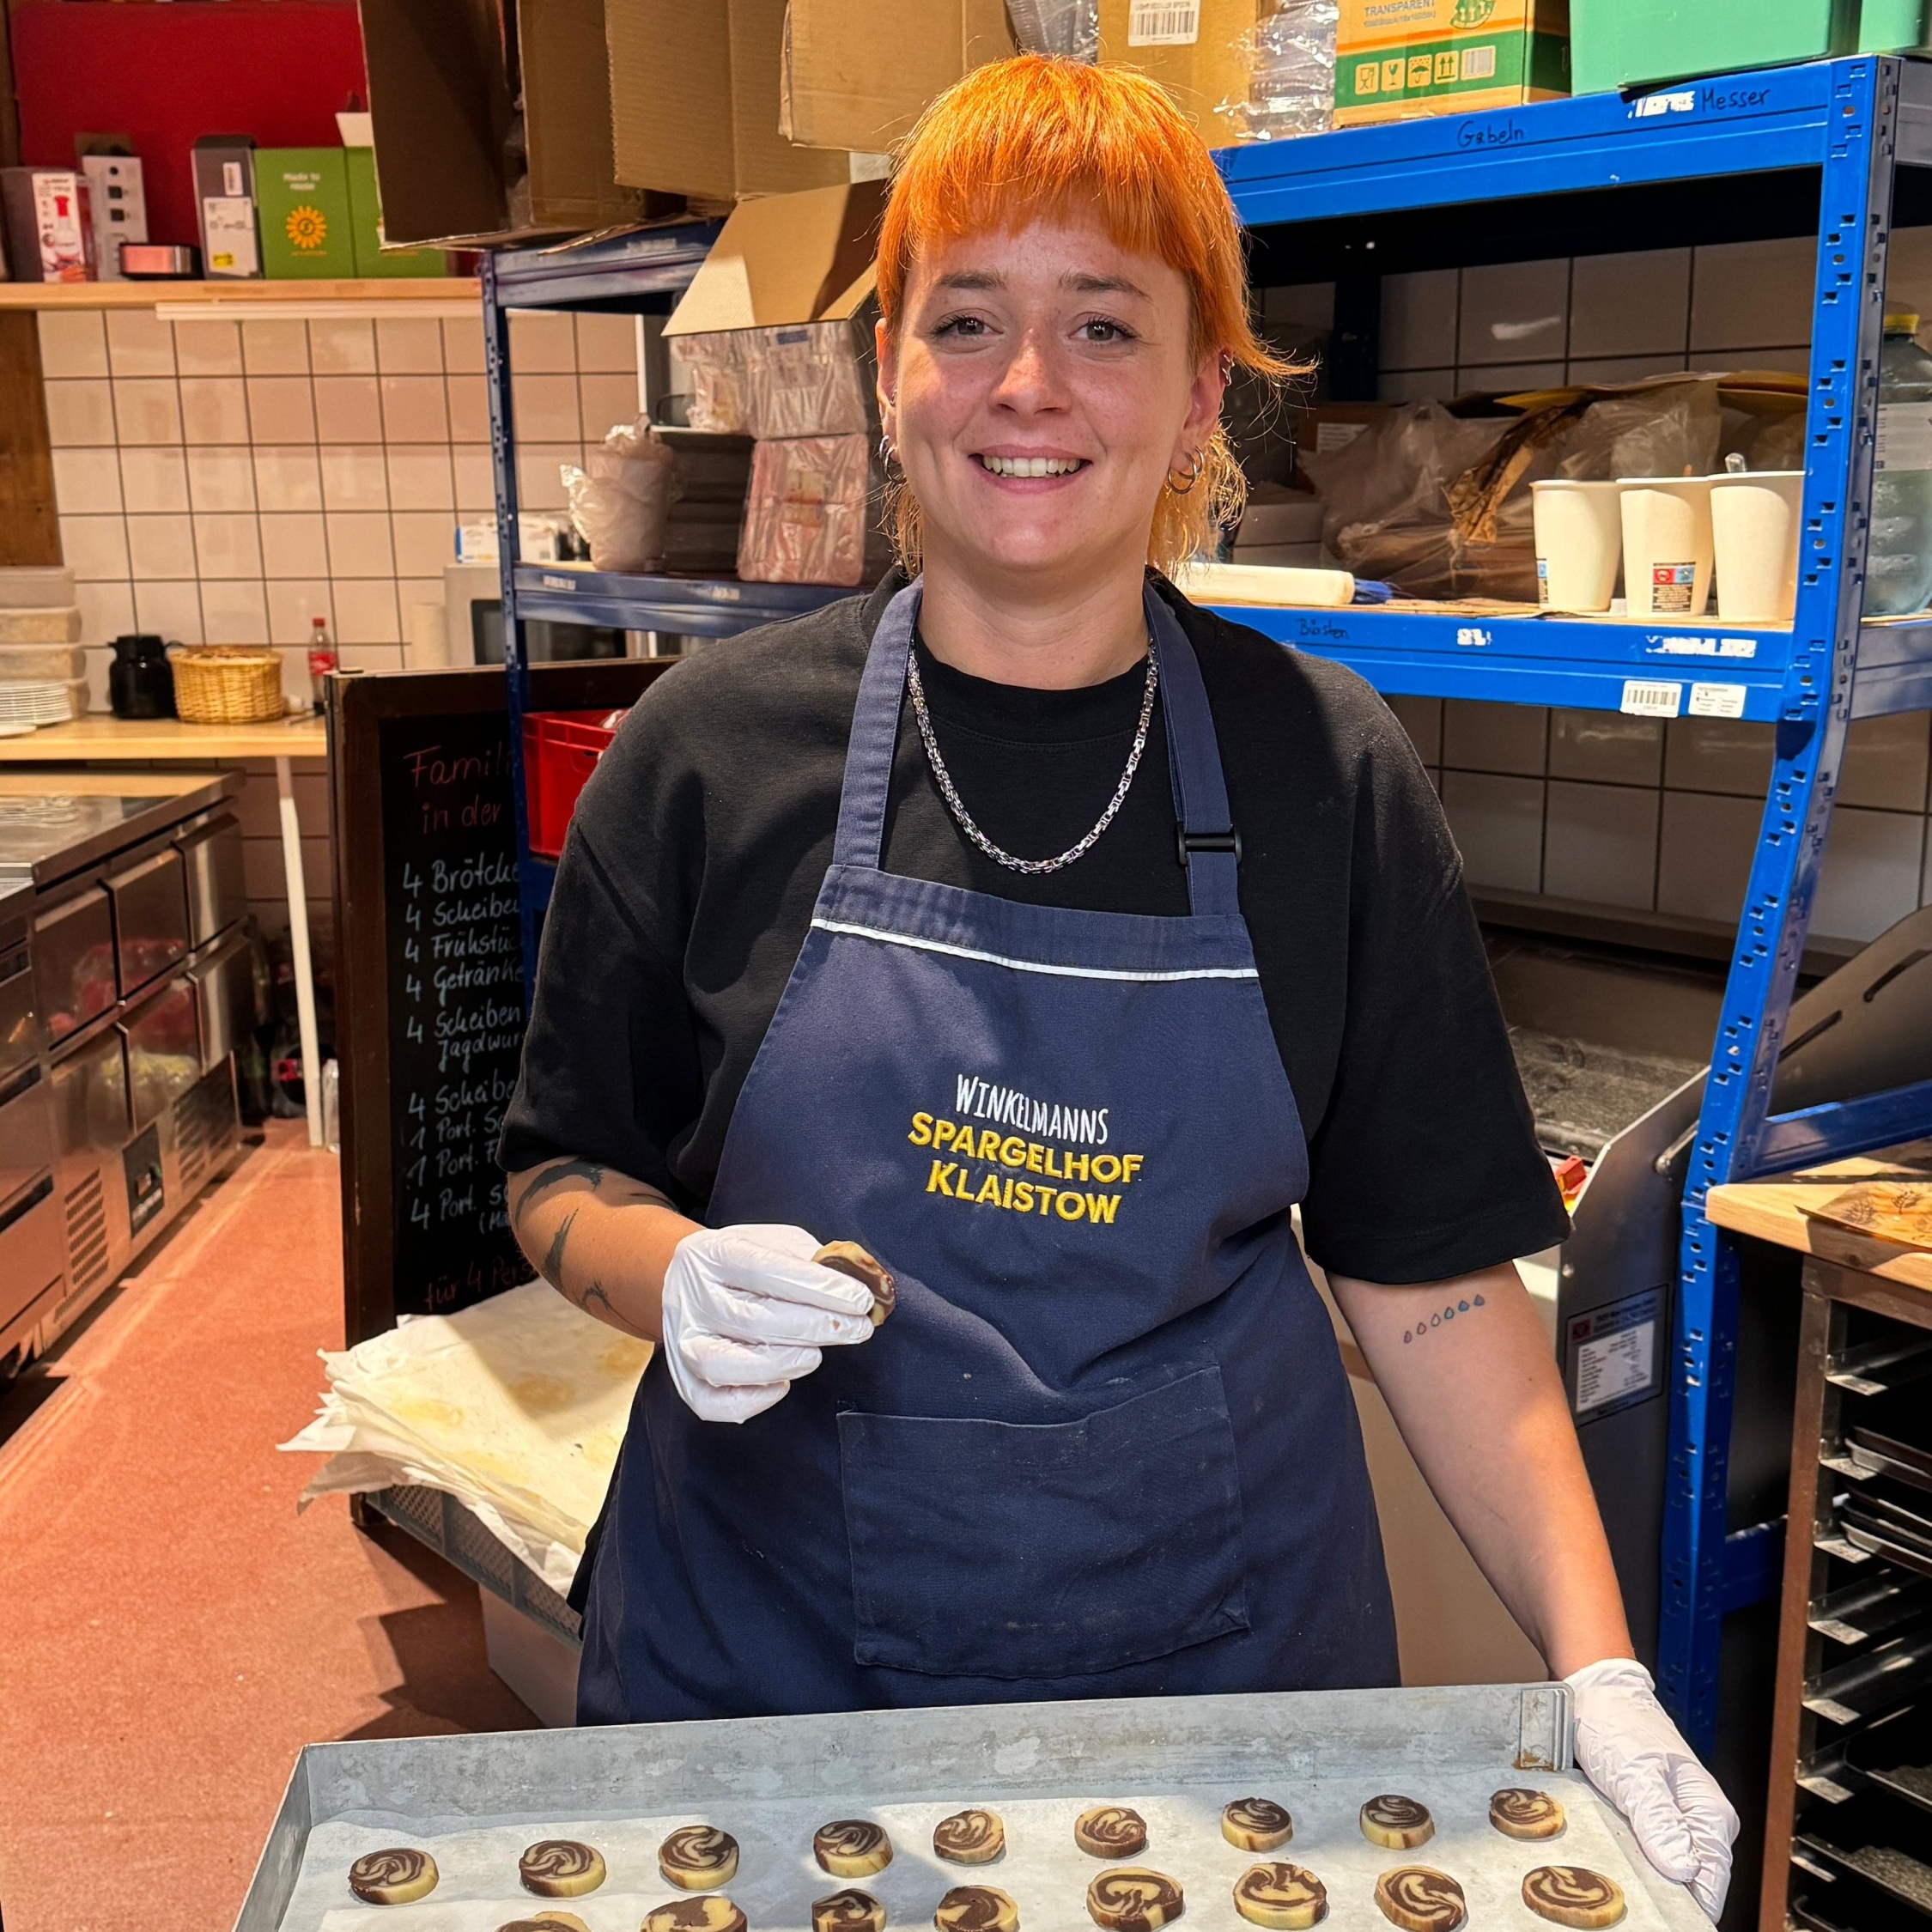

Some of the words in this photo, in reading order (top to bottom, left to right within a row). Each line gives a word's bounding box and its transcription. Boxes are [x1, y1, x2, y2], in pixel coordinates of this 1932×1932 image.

[1701, 87, 1771, 112] Messer
[1457, 118, 1525, 148] Gabeln
[420, 801, 450, 835] in
[460, 792, 502, 828] der
[402, 860, 424, 899] 4
[404, 902, 422, 932] 4
[404, 937, 421, 964] 4
[404, 972, 423, 1003] 4
[406, 1015, 423, 1045] 4
[434, 997, 521, 1037] Scheiben
[436, 1030, 524, 1074] Jagdwur
[407, 1091, 427, 1122] 4
[956, 1073, 1109, 1145] WINKELMANNS
[409, 1125, 427, 1151] 1
[907, 1111, 1145, 1184] SPARGELHOF
[406, 1153, 428, 1188] 1
[435, 1142, 480, 1179] Port.
[926, 1159, 1122, 1224] KLAISTOW
[410, 1196, 431, 1231] 4
[422, 1274, 461, 1314] für
[465, 1260, 483, 1295] 4
